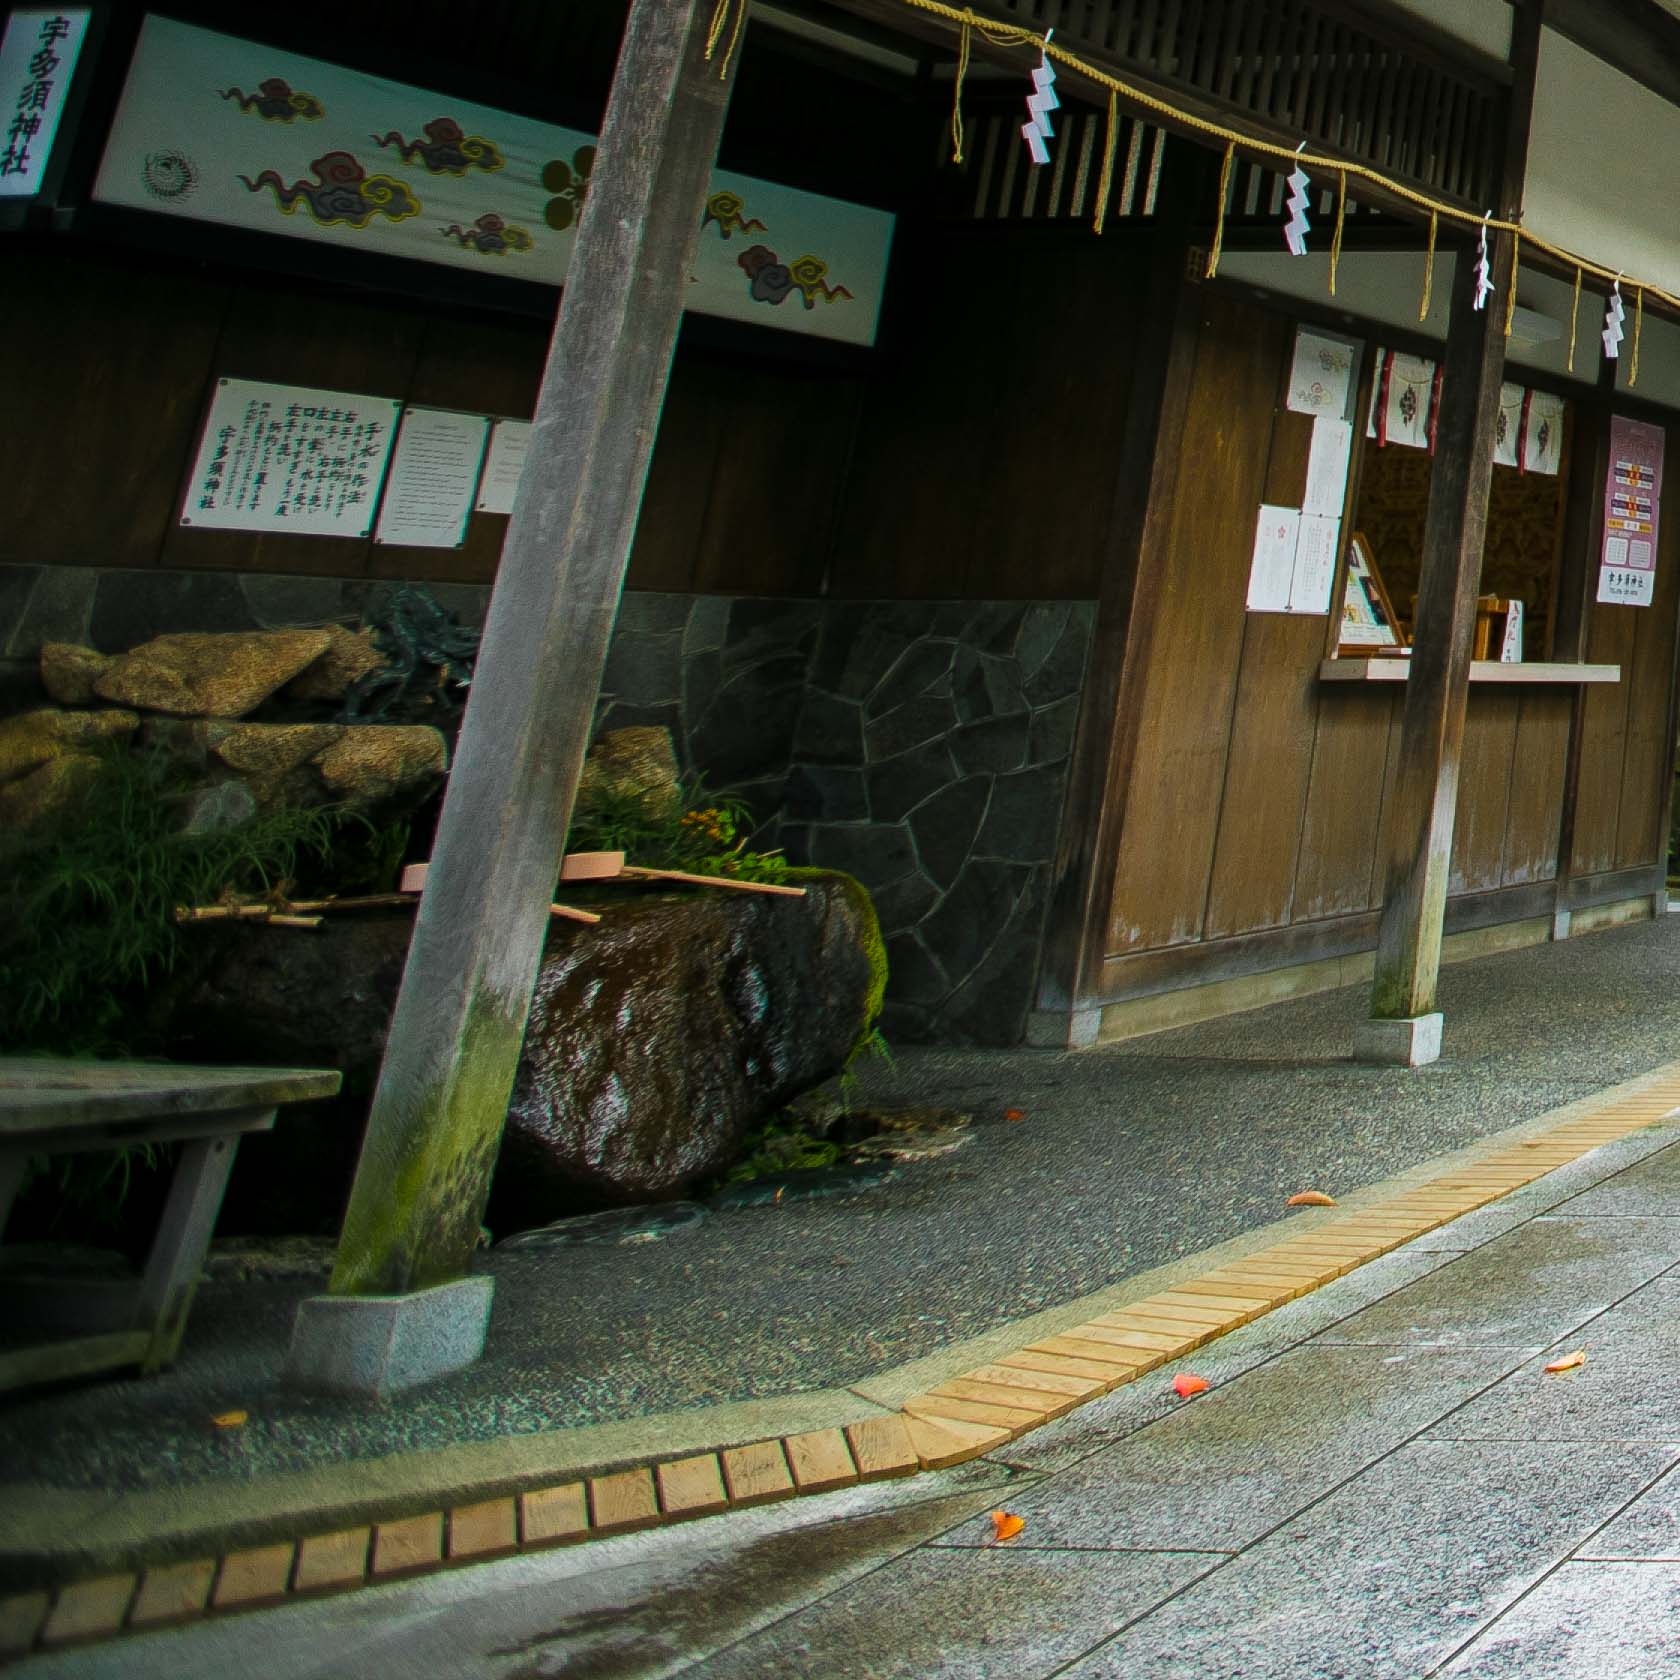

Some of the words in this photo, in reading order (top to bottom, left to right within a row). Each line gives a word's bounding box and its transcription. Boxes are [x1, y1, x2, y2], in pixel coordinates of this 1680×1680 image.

[0, 16, 71, 177] 宇多須神社
[198, 425, 237, 509] 宇多須神社
